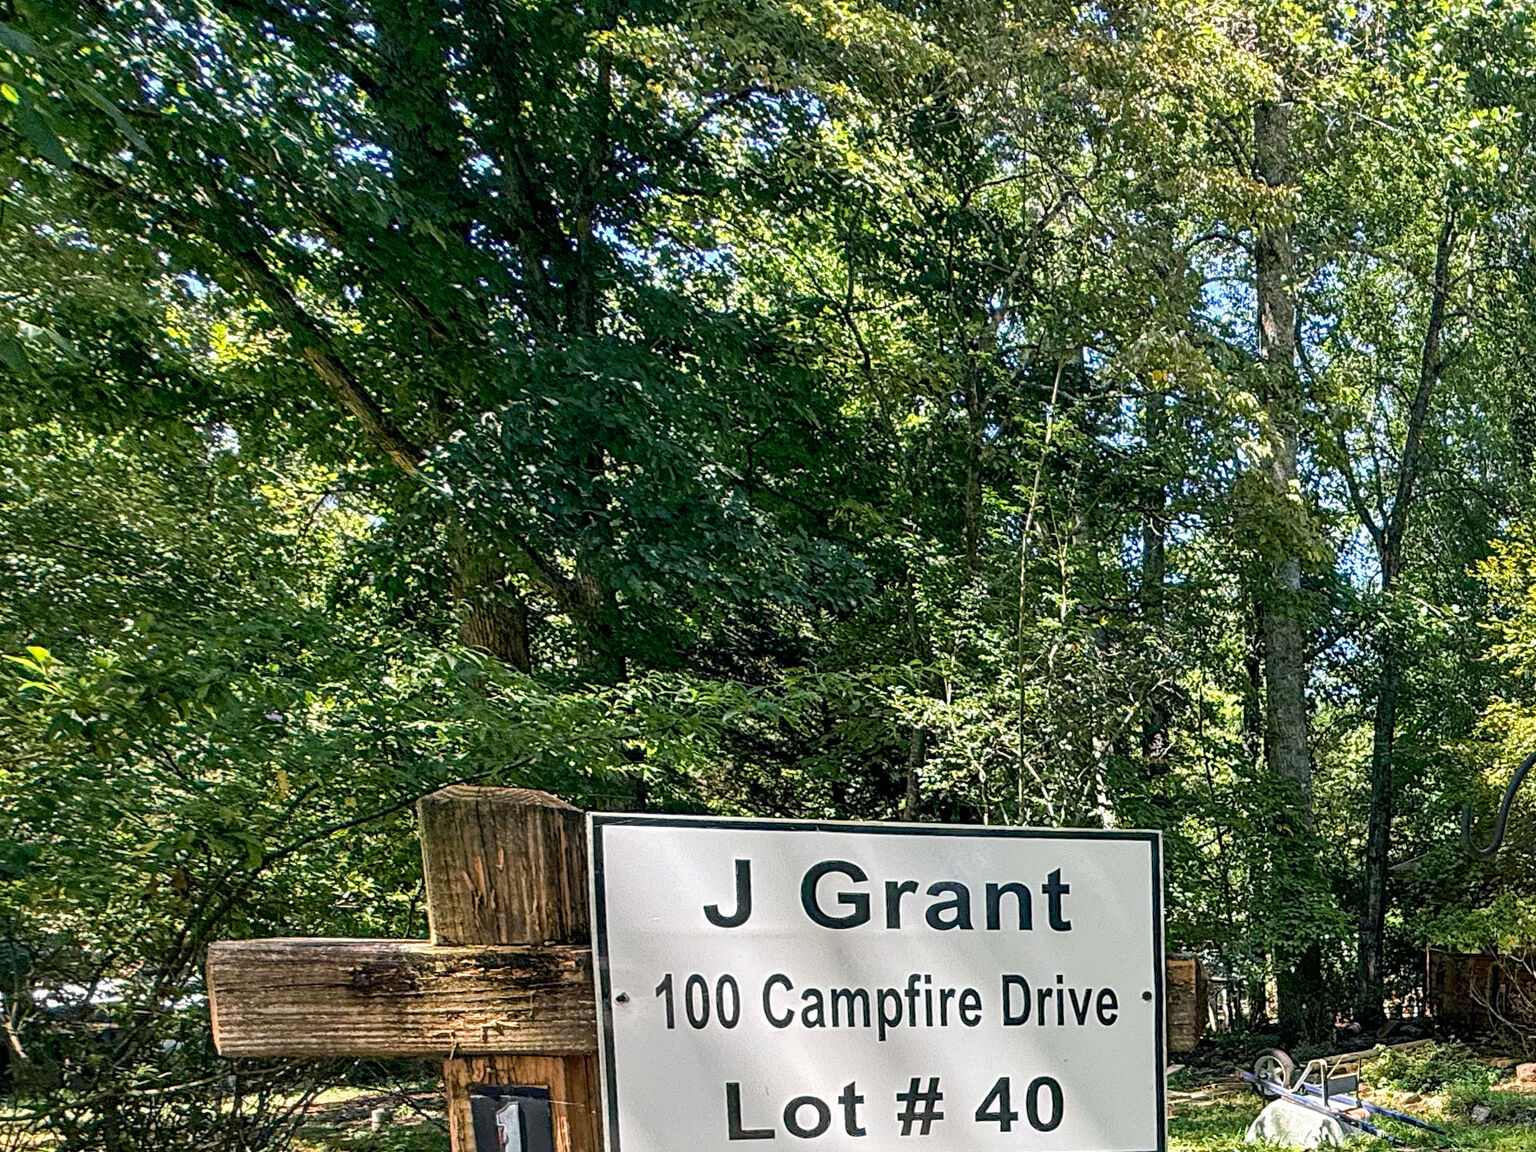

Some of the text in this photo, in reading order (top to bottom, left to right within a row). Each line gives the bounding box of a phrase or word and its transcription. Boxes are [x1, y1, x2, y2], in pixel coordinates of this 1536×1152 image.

[703, 858, 1073, 932] J Grant
[654, 972, 1119, 1042] 100 Campfire Drive
[725, 1075, 1065, 1142] Lot # 40
